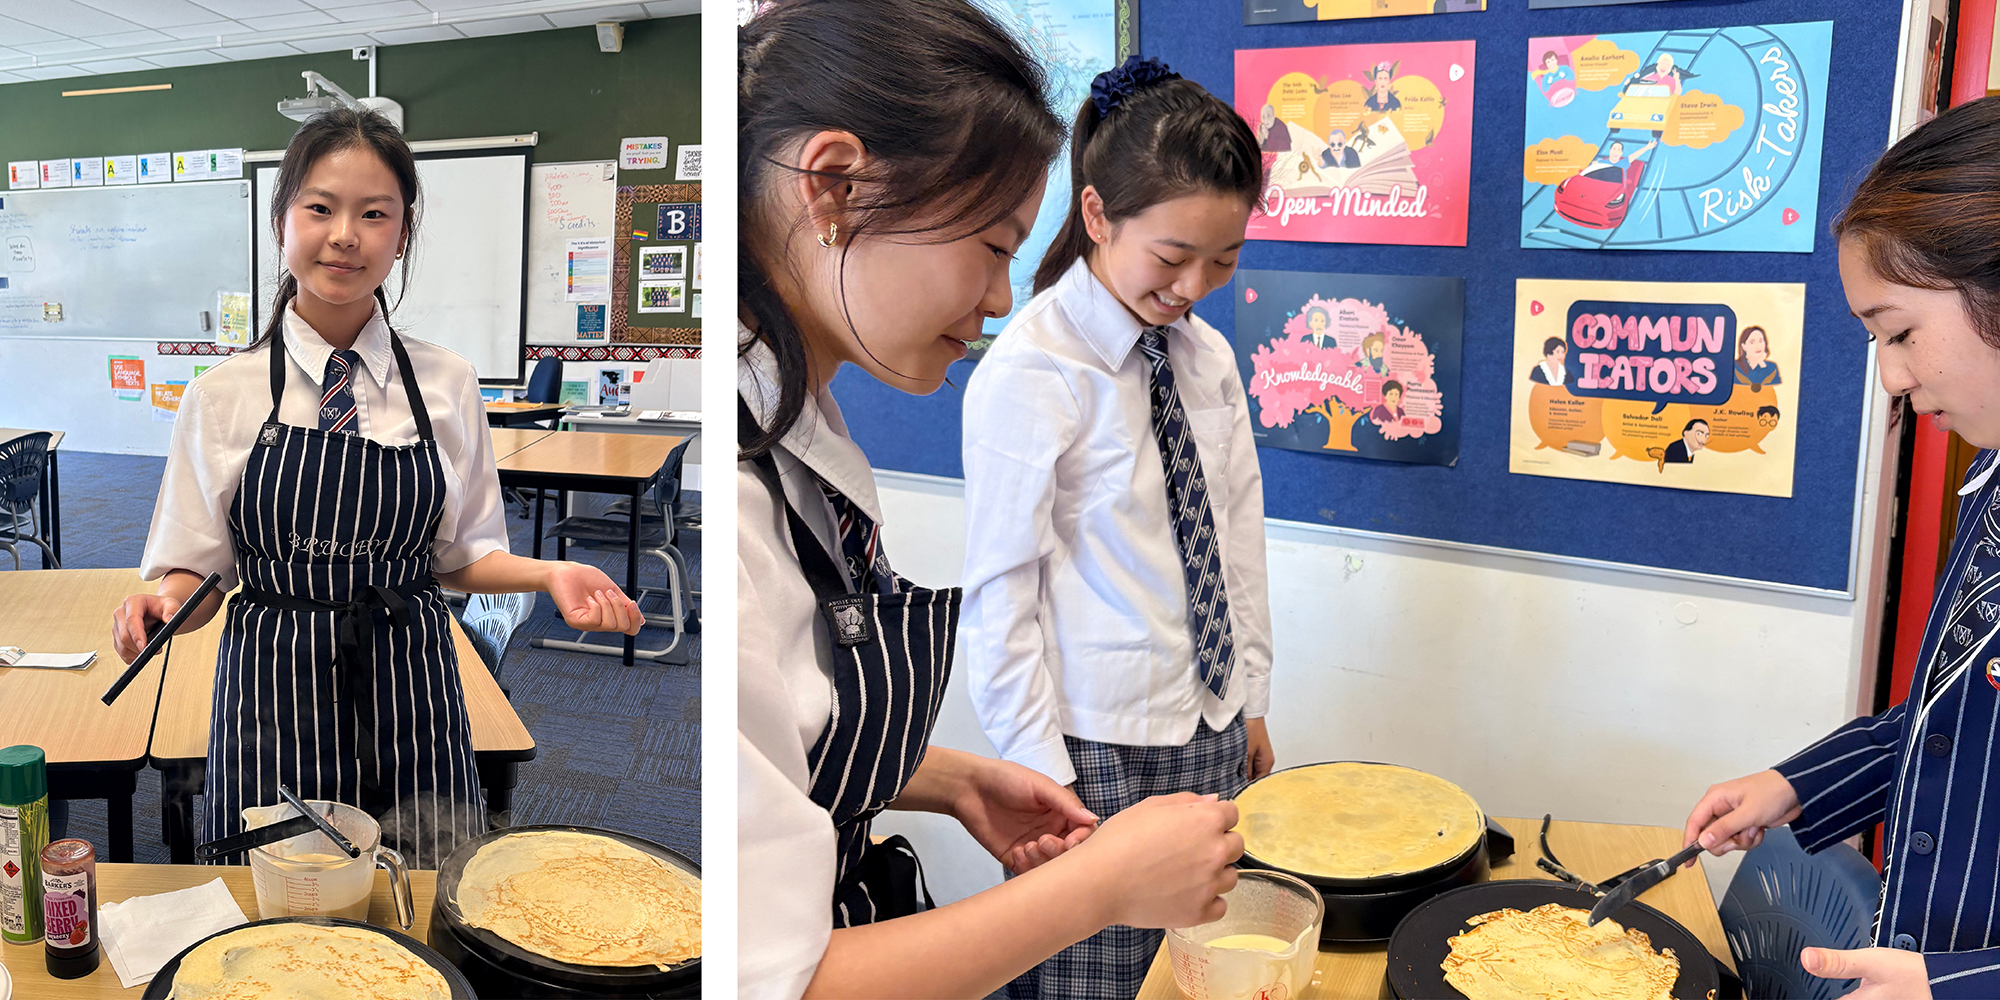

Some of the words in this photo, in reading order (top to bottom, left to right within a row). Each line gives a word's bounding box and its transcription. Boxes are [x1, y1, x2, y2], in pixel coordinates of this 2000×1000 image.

[1699, 46, 1799, 228] Risk-Takers
[75, 166, 81, 176] X
[108, 165, 114, 174] A
[141, 162, 147, 172] X
[177, 160, 184, 170] A
[211, 158, 216, 168] S
[1264, 185, 1428, 226] Open-Minded
[567, 218, 595, 230] credits
[667, 210, 685, 234] B
[1572, 313, 1725, 353] COMMUN
[1260, 362, 1363, 394] Knowledgeable
[1577, 352, 1718, 395] ICATORS
[45, 880, 72, 888] BARKER'S
[45, 899, 77, 918] MIXED
[46, 915, 78, 934] BERRY
